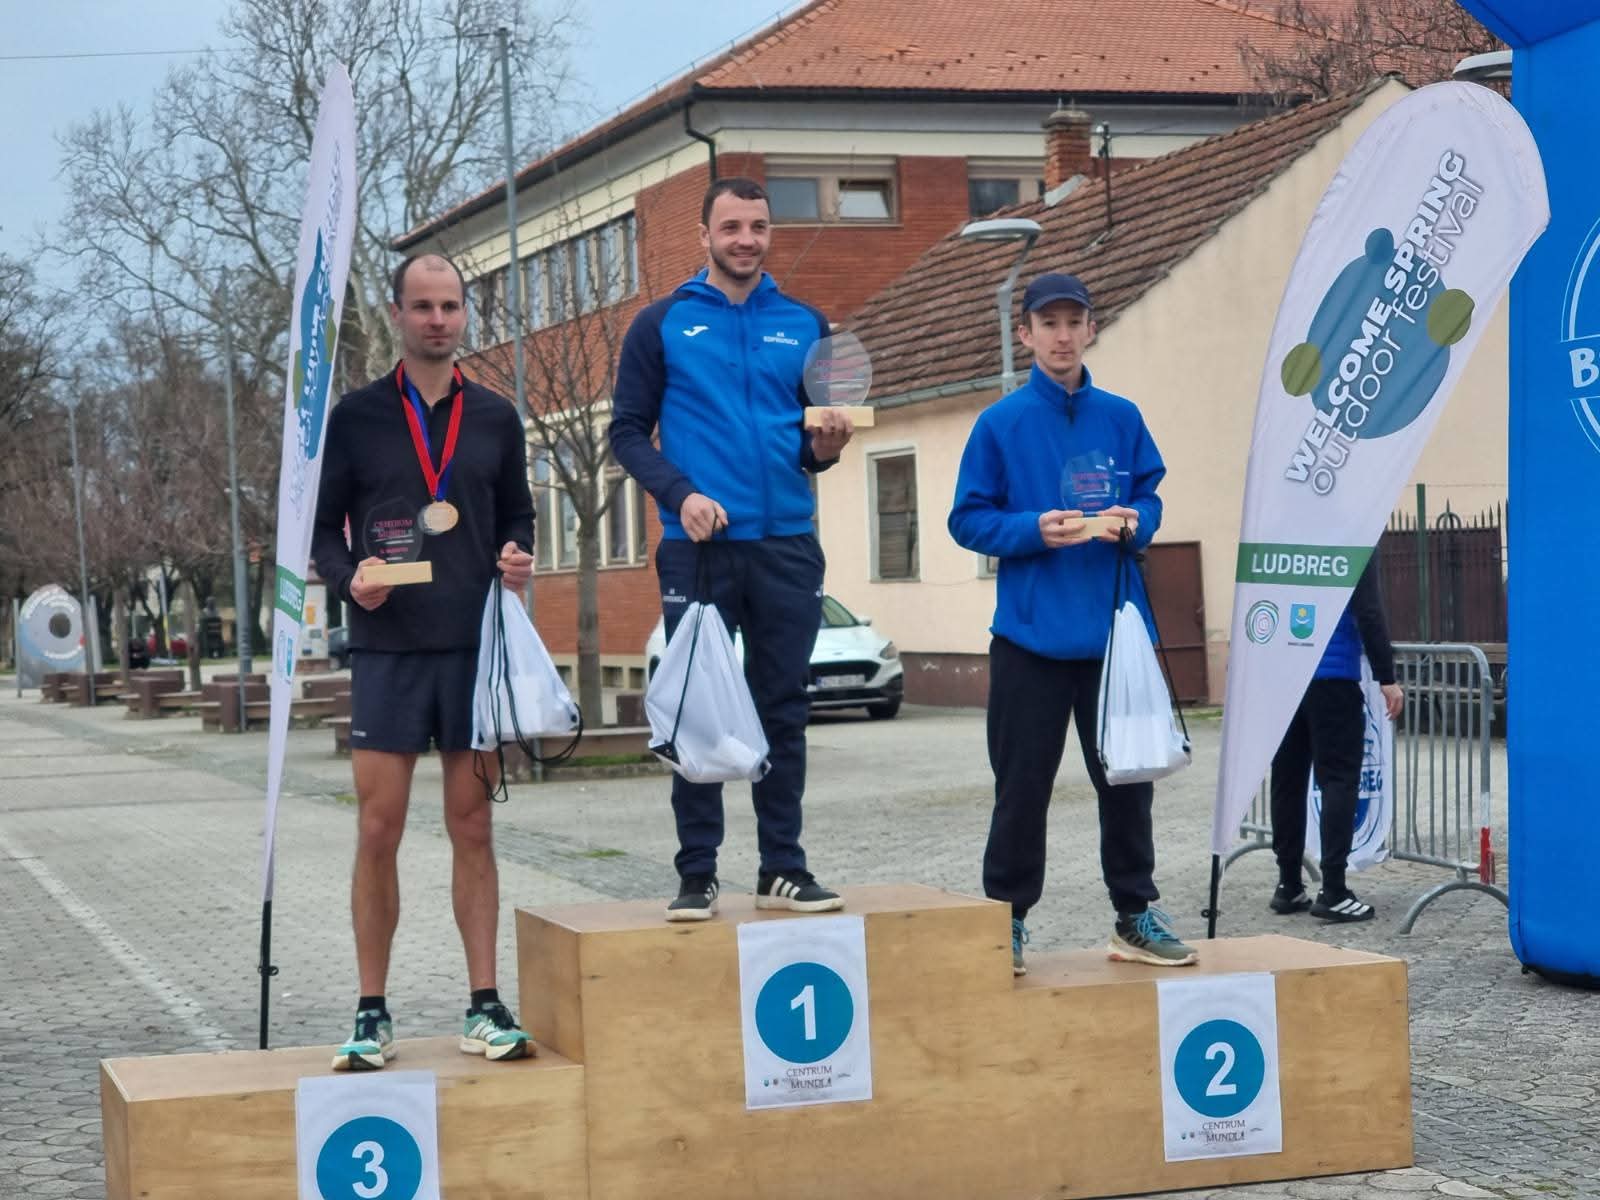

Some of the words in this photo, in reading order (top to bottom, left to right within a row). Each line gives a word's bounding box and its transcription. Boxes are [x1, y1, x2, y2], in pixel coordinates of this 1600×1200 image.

[1285, 297, 1392, 481] WELCOME
[1384, 151, 1464, 293] SPRING
[1312, 328, 1401, 494] outdoor
[1392, 175, 1482, 324] festival
[1569, 347, 1600, 388] B
[1251, 553, 1349, 577] LUDBREG
[790, 984, 817, 1041] 1
[786, 1065, 833, 1078] CENTRUM
[1204, 1041, 1238, 1097] 2
[1202, 1119, 1246, 1131] CENTRUM
[351, 1140, 389, 1199] 3
